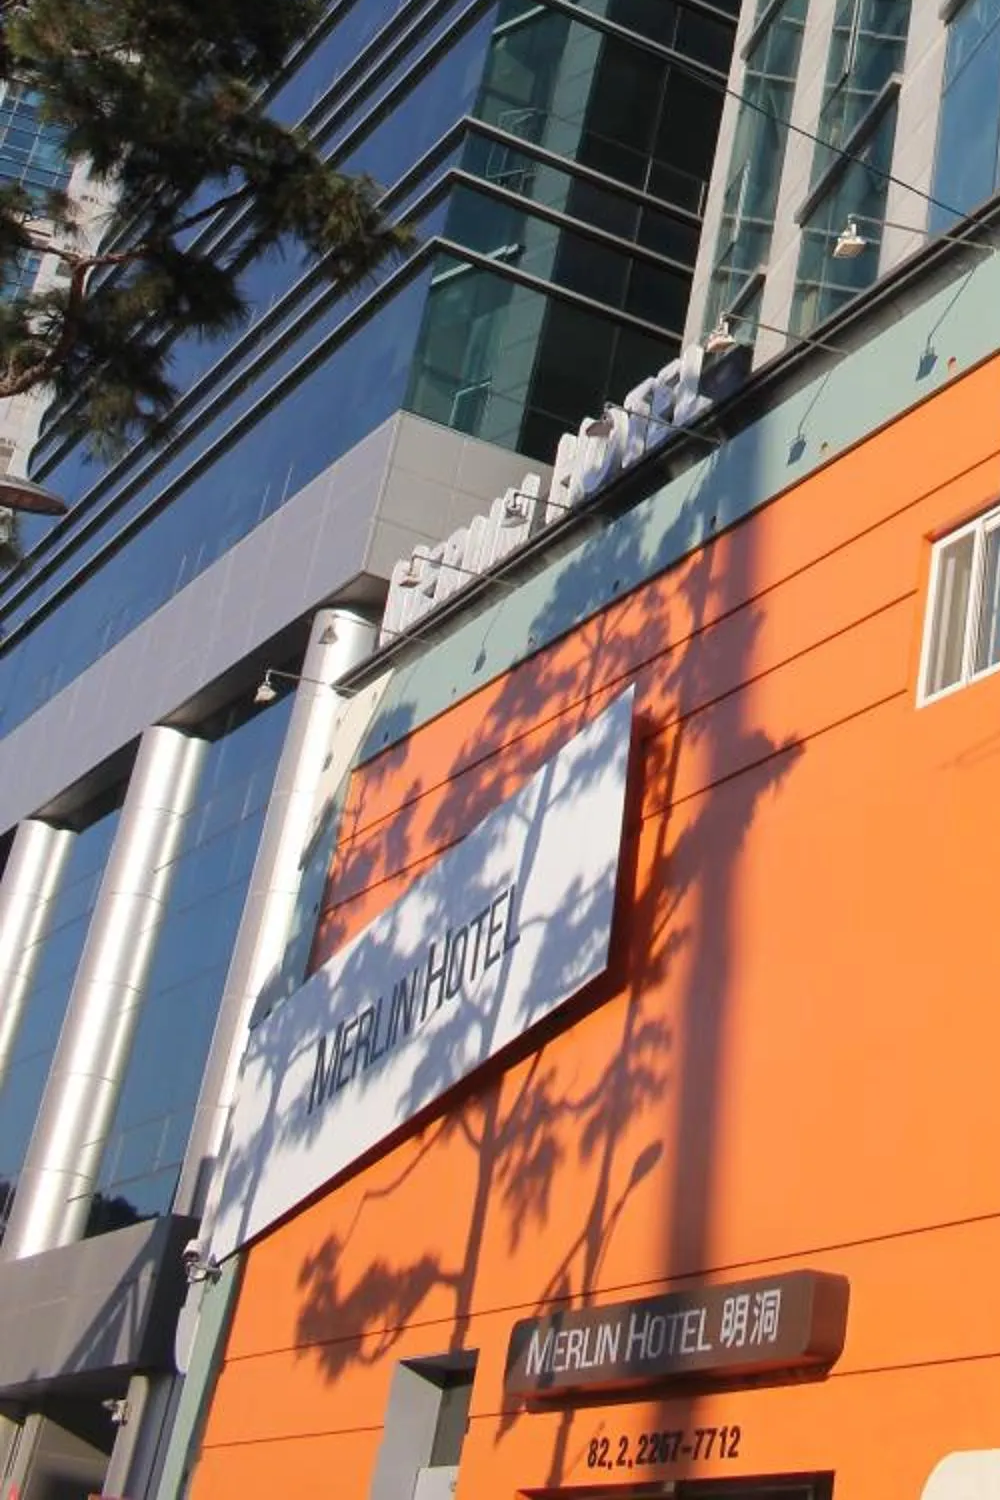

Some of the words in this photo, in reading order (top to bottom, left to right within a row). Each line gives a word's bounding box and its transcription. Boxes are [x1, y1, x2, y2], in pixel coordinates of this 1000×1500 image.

[308, 967, 418, 1115] MERLIN
[420, 884, 520, 1023] HOTEL
[525, 1321, 621, 1375] MERLIN
[625, 1307, 713, 1362] HOTEL
[719, 1288, 782, 1348] 明洞
